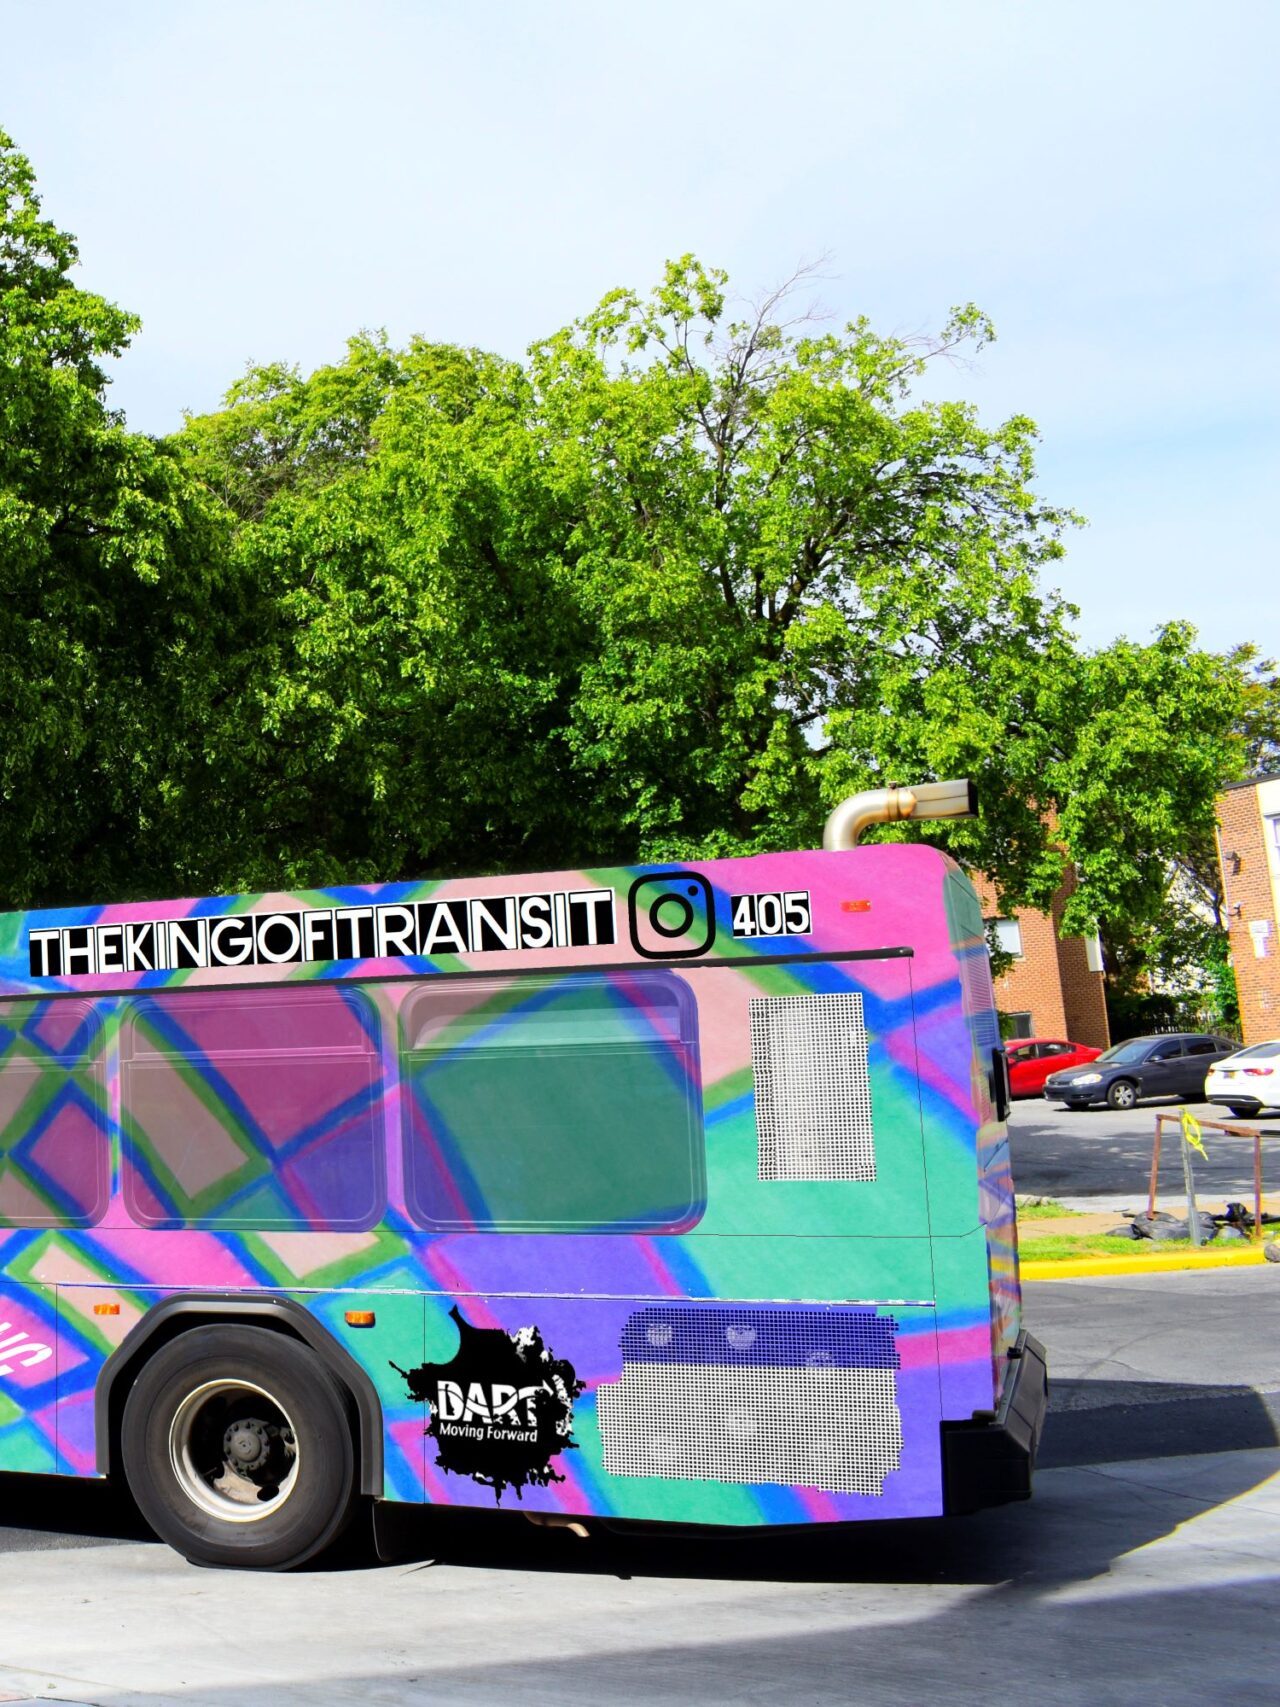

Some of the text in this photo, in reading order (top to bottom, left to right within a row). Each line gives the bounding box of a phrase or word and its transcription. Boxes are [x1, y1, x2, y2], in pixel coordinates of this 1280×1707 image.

[29, 889, 613, 976] THEKINGOFTRANSIT
[733, 892, 810, 936] 405
[437, 1380, 554, 1427] DART
[440, 1422, 538, 1443] Moving Forward
